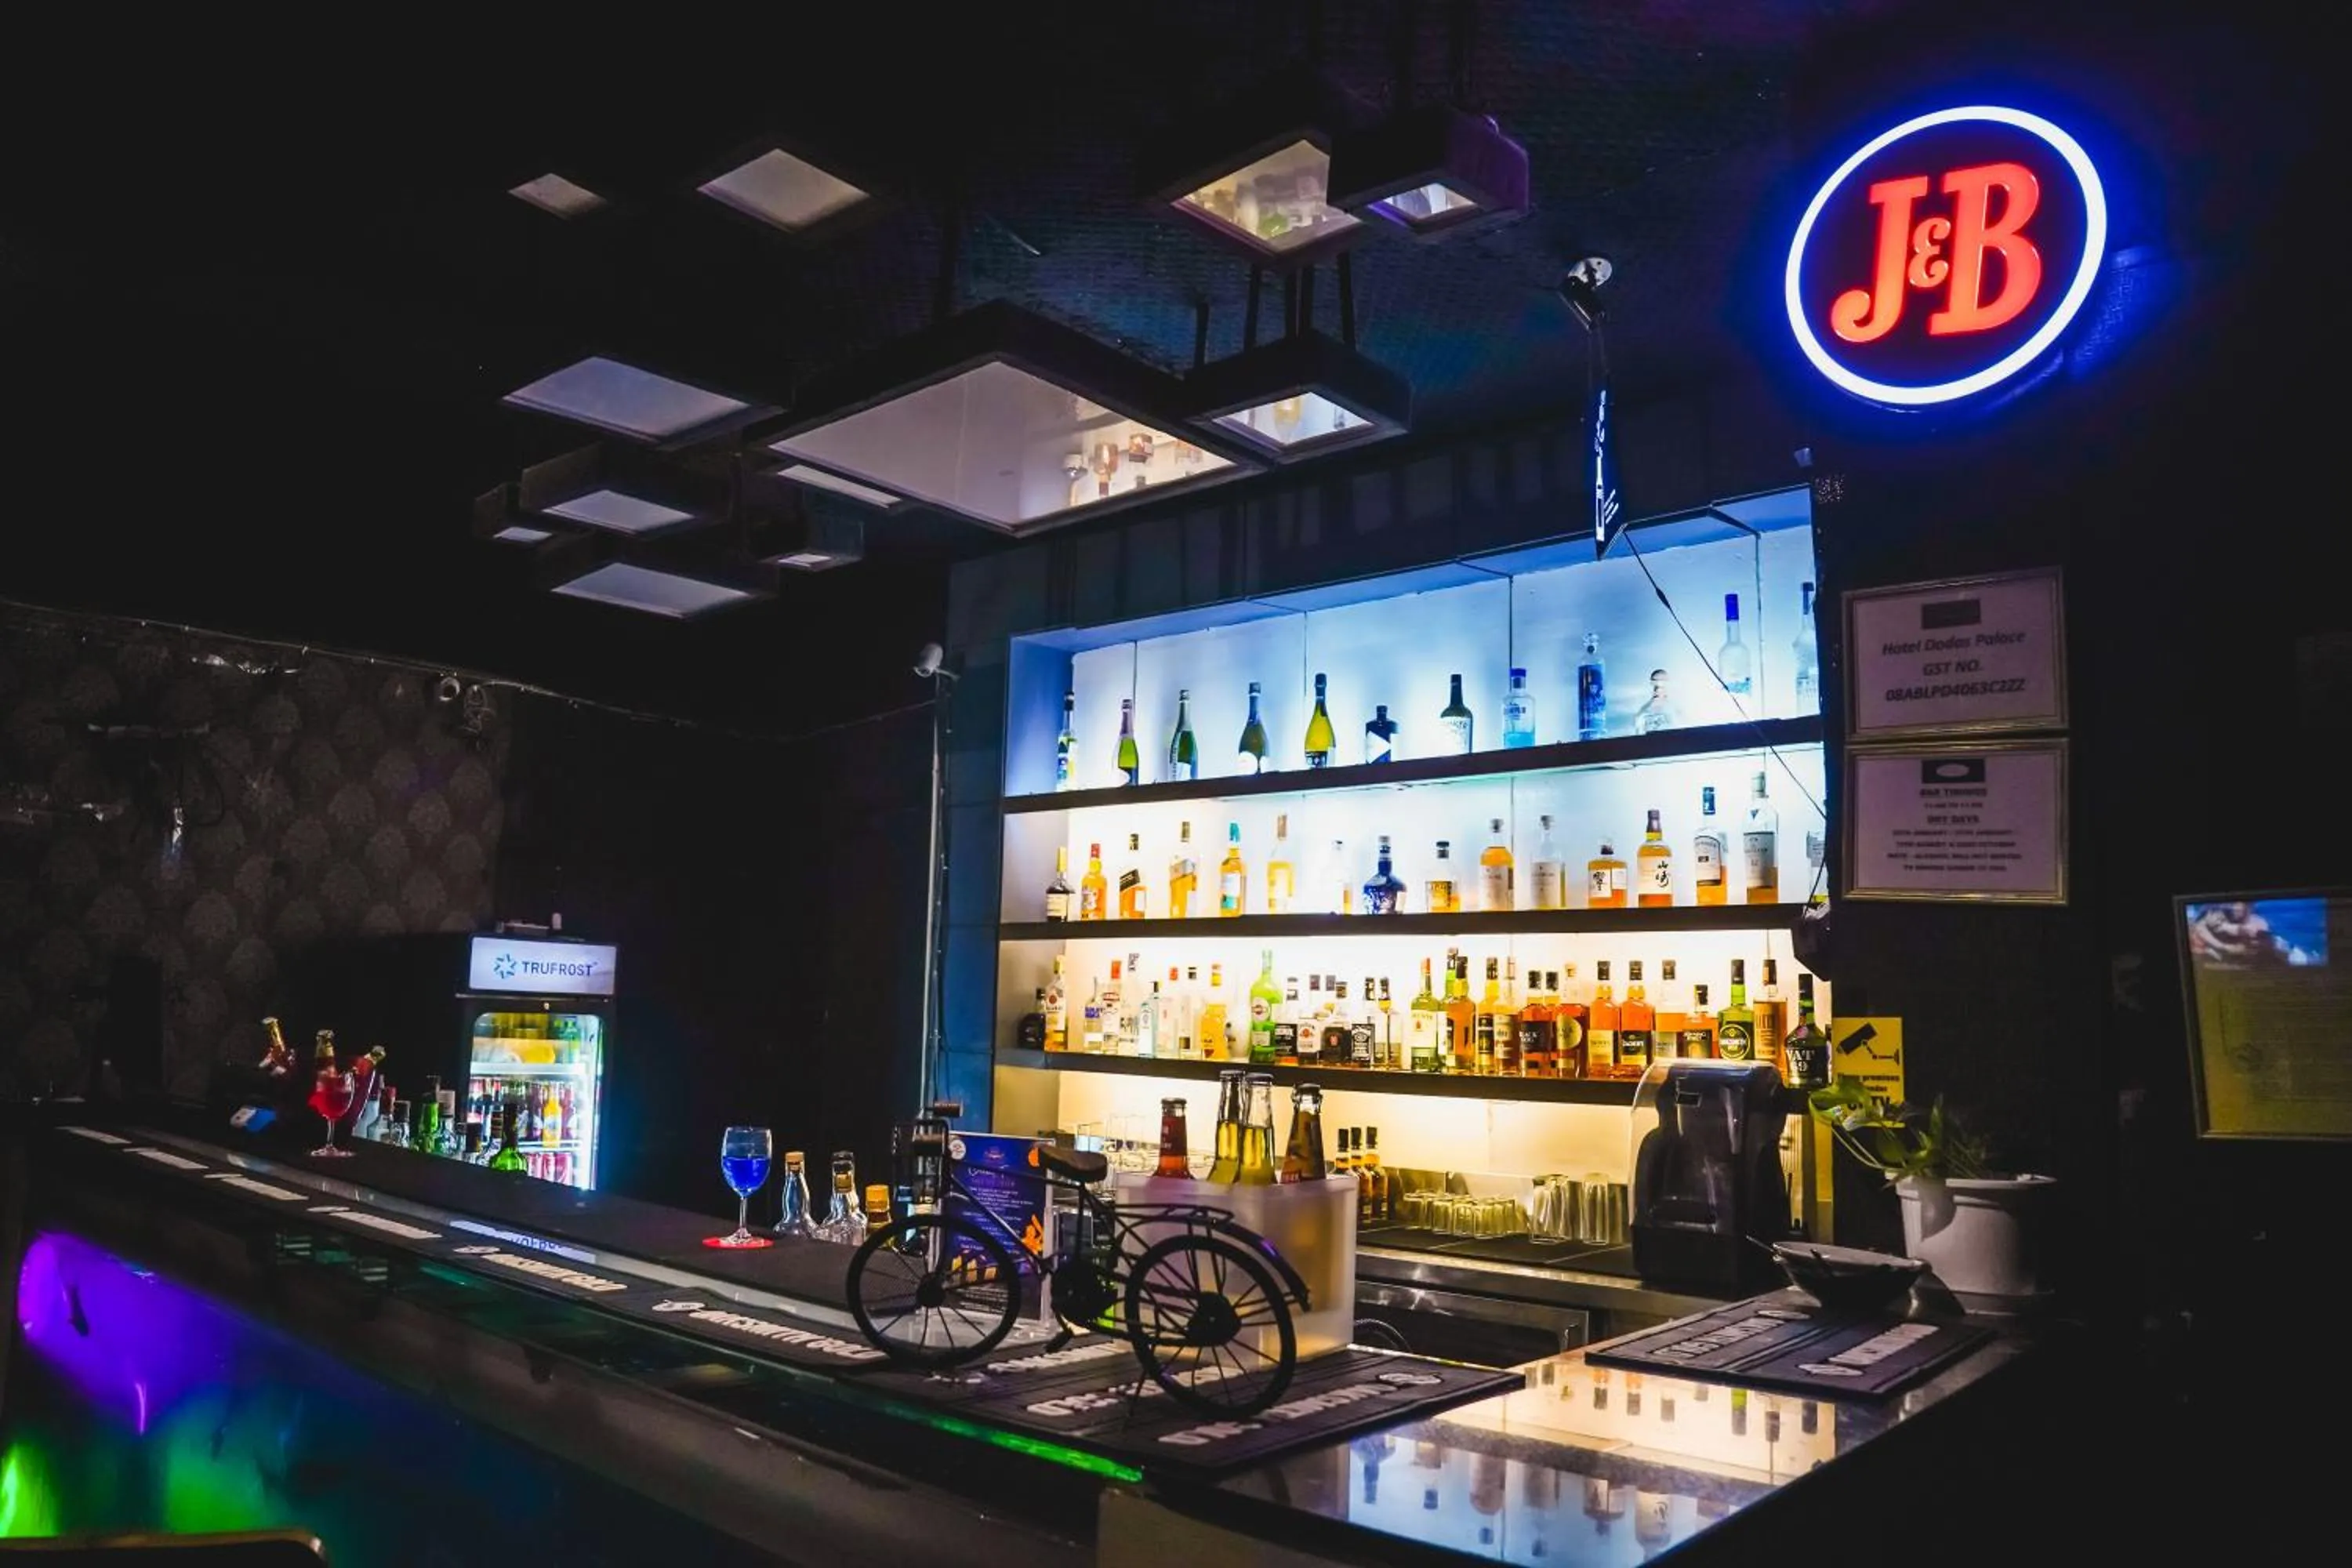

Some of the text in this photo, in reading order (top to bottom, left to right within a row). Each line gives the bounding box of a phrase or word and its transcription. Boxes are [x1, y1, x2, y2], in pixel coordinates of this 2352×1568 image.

[1831, 162, 2042, 343] J&B
[1882, 639, 1922, 655] Hotel
[1975, 631, 2026, 647] Palace
[1923, 662, 1951, 676] GST
[521, 961, 593, 976] TRUFROST
[1785, 1049, 1816, 1061] VAT
